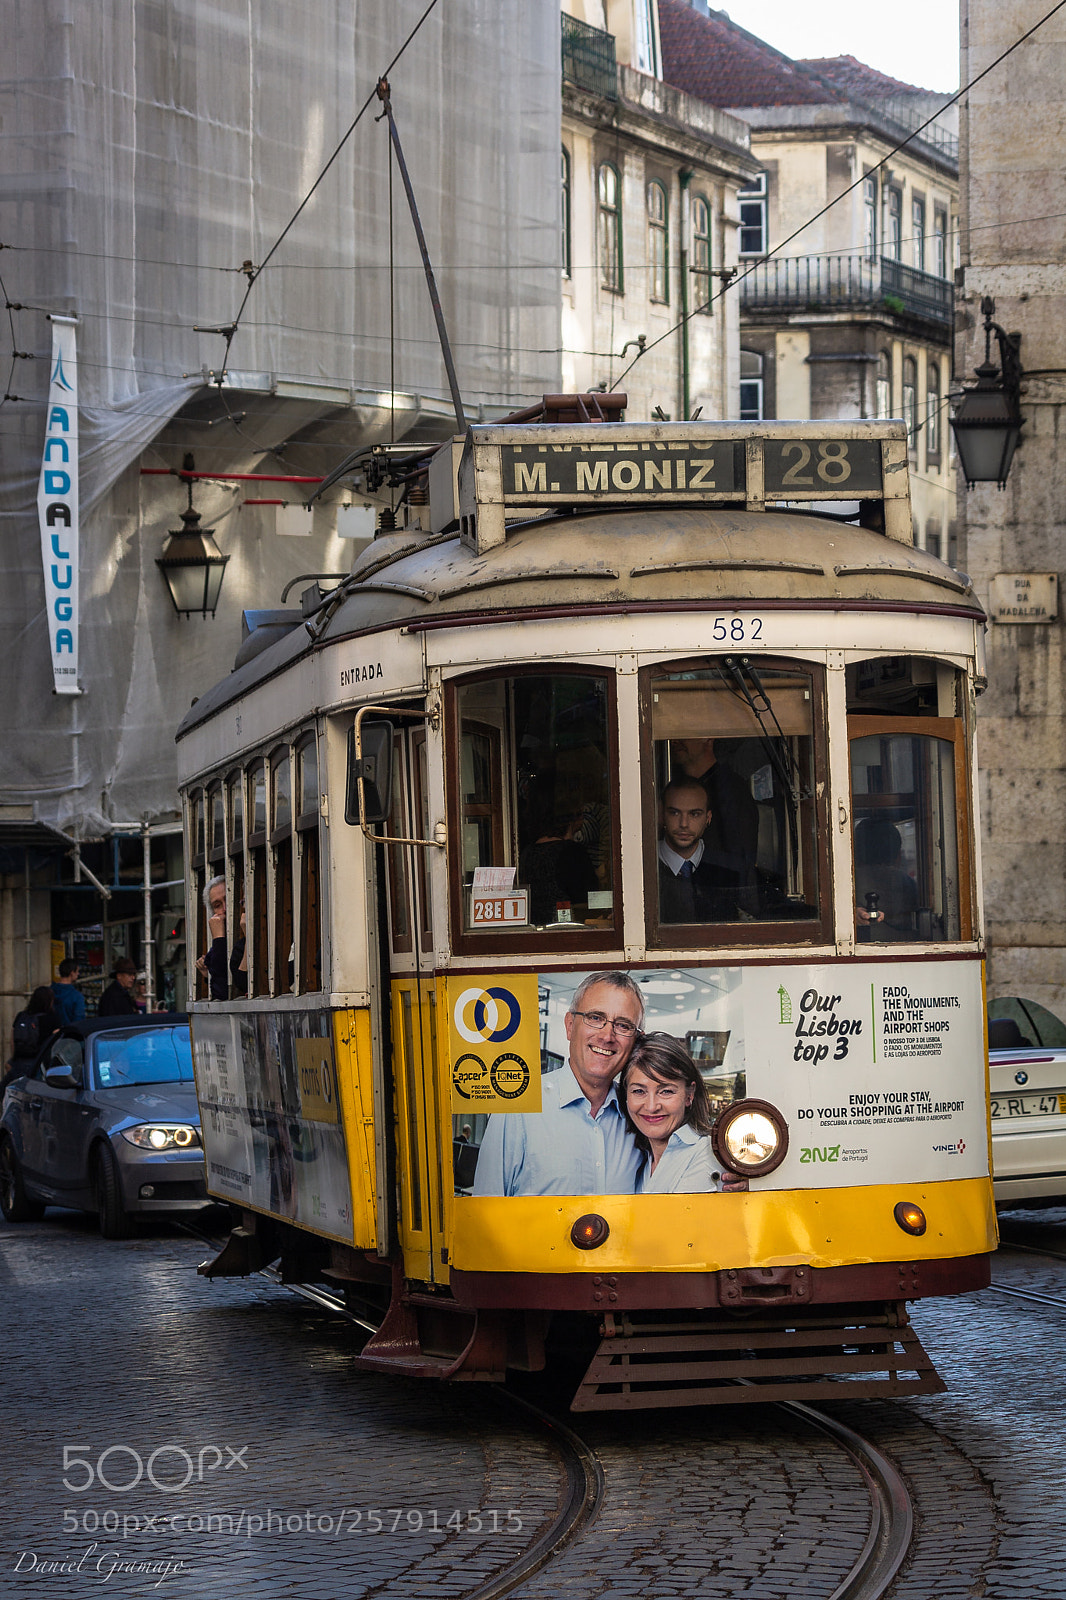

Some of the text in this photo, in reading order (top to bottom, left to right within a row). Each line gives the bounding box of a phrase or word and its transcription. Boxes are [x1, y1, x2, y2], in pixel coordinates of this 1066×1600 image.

[781, 440, 852, 485] 28
[514, 459, 716, 491] M. MONIZ
[44, 406, 73, 654] ANDALUGA
[1014, 579, 1031, 588] RUA
[1016, 593, 1029, 602] DA
[712, 617, 763, 641] 582
[340, 662, 383, 687] ENTRADA
[475, 901, 502, 919] 28E
[800, 988, 842, 1012] Our
[882, 986, 911, 998] FADO,
[883, 996, 961, 1010] THE MONUMENTS,
[883, 1009, 924, 1022] AND THE
[795, 1013, 863, 1037] Lisbon
[883, 1020, 950, 1034] AIRPORT SHOPS
[793, 1036, 849, 1065] top 3
[458, 1072, 482, 1084] apcer
[497, 1072, 522, 1082] IQNet
[849, 1091, 931, 1106] ENJOY YOUR STAY,
[797, 1101, 965, 1120] DO YOUR SHOPPING AT THE AIRPORT
[932, 1144, 956, 1152] VINCI
